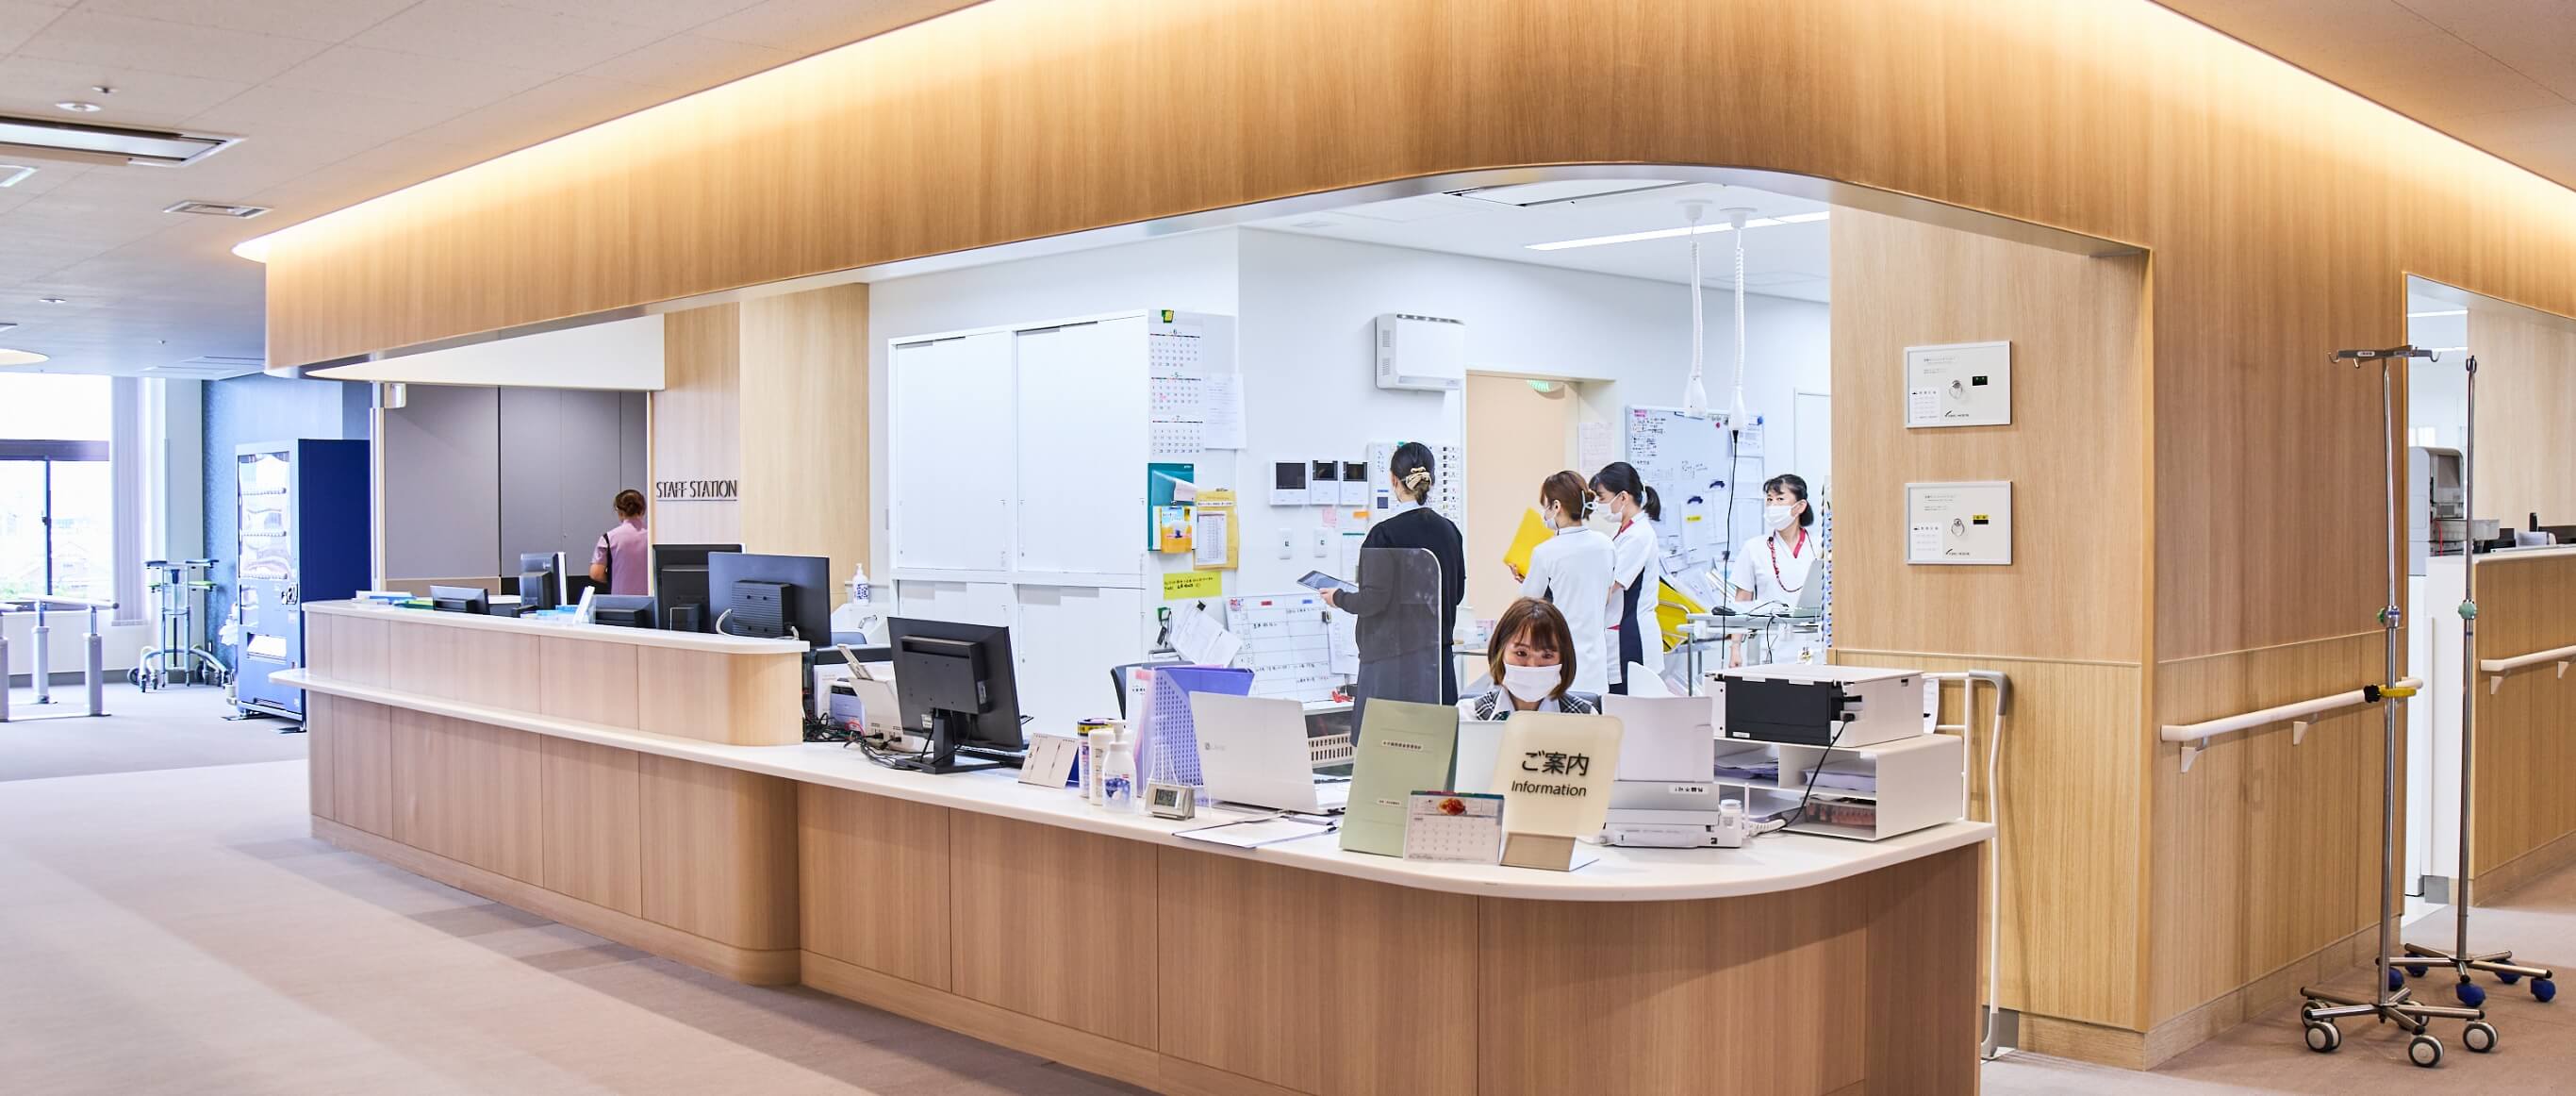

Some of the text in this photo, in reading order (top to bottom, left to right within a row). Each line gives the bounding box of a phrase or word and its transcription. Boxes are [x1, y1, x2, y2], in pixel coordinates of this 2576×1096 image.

[656, 480, 737, 498] STAFF STATION
[1522, 750, 1590, 776] ご案内
[1511, 780, 1587, 797] Information
